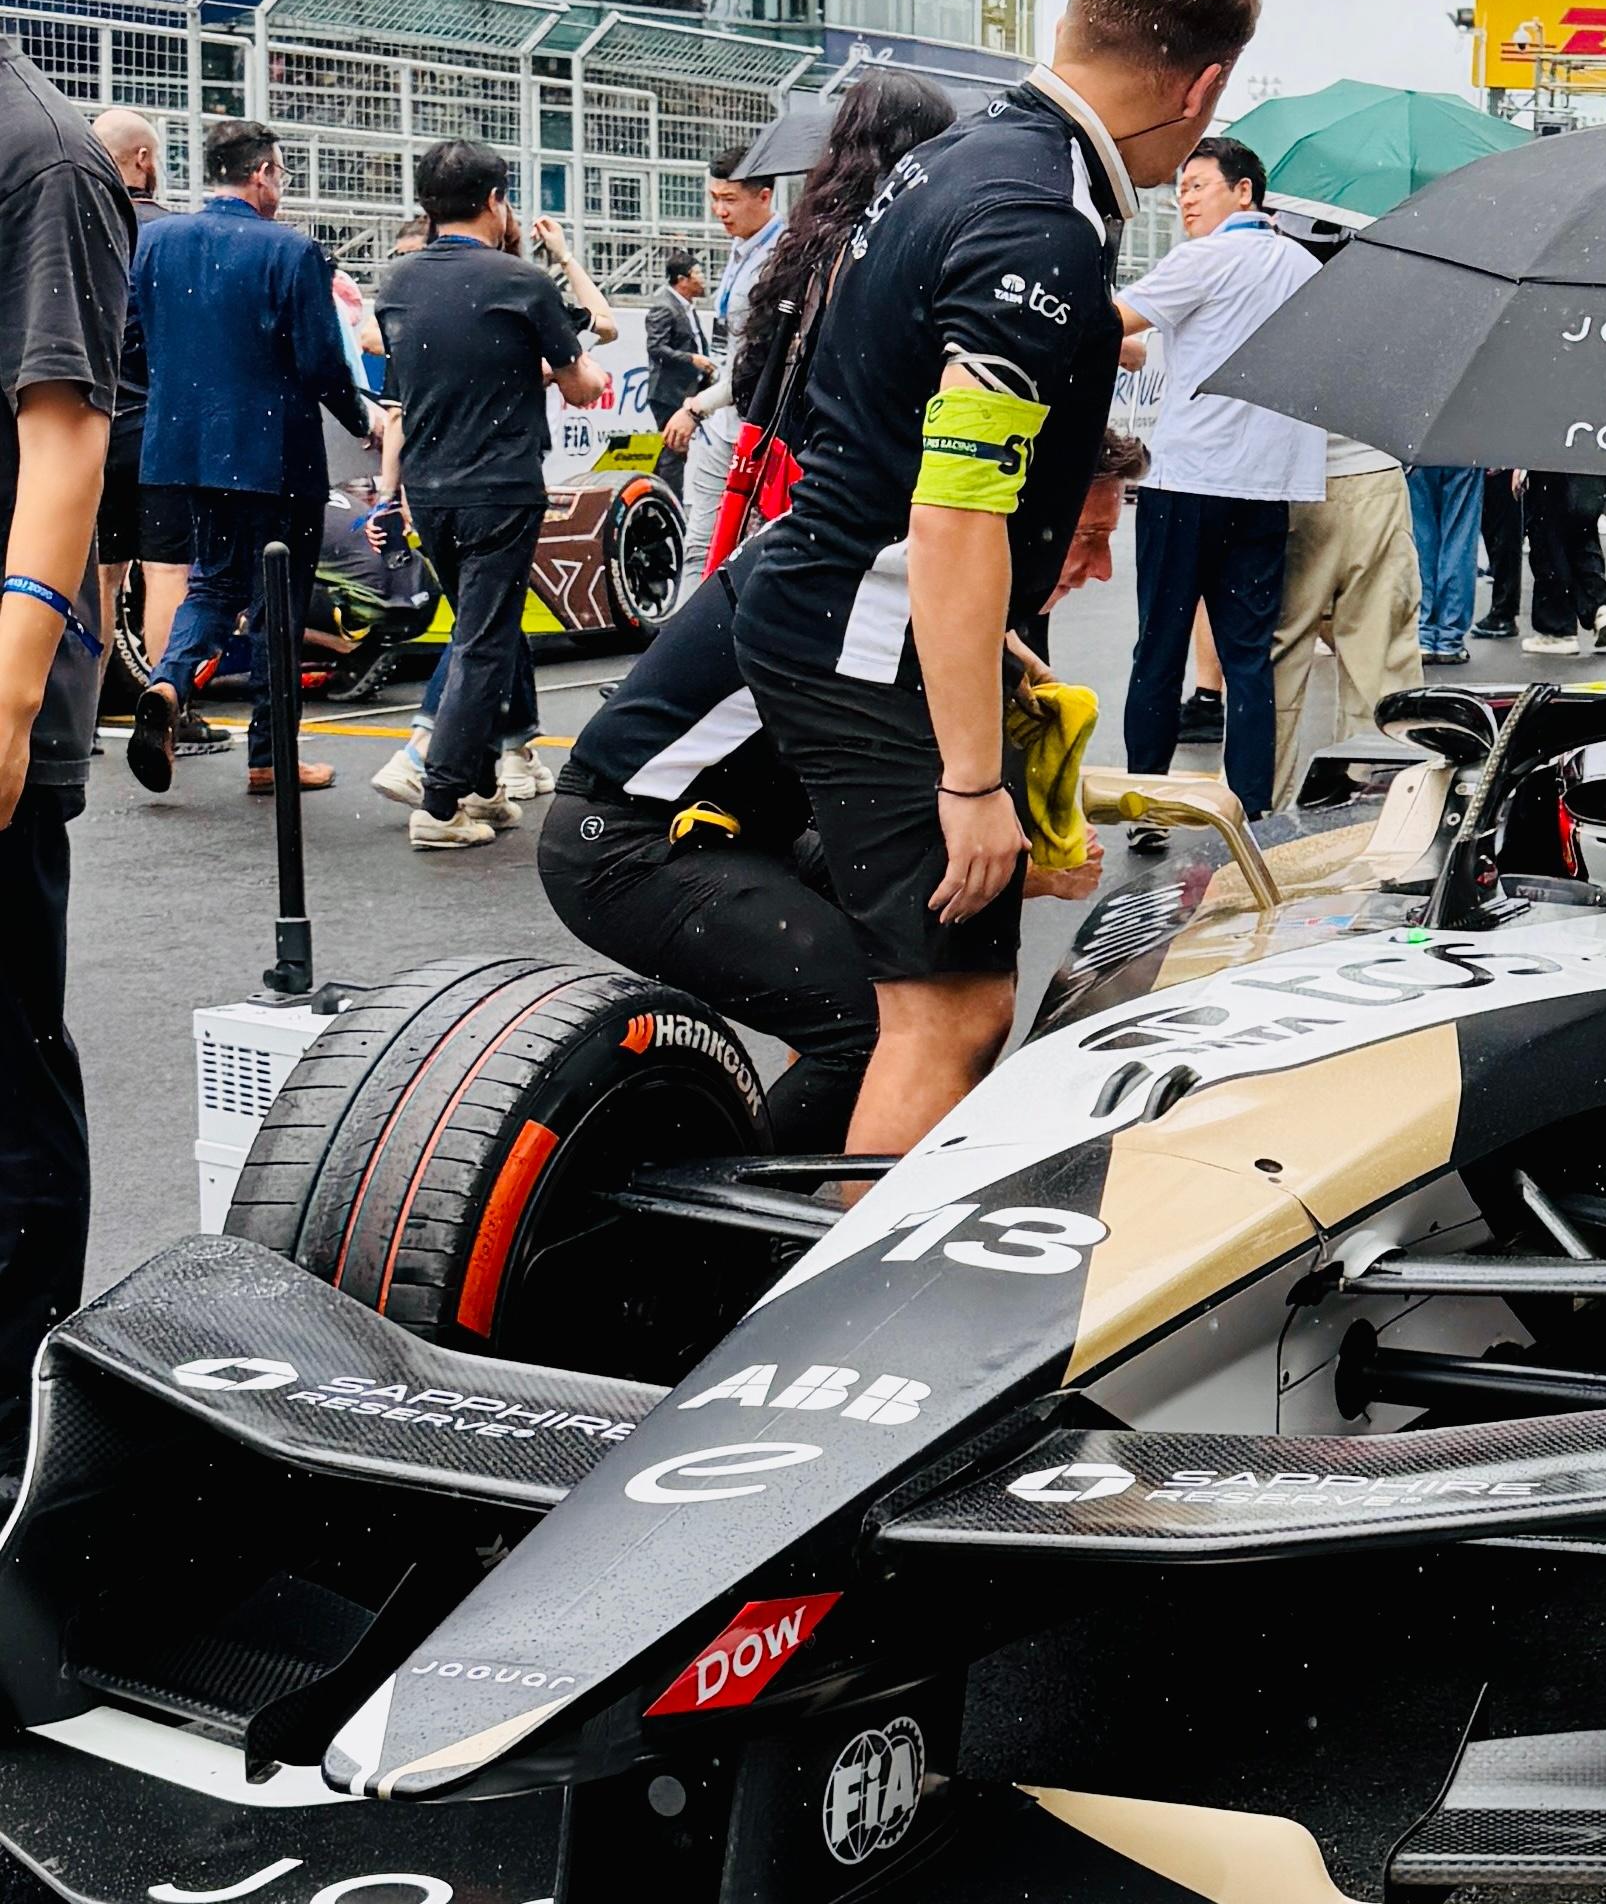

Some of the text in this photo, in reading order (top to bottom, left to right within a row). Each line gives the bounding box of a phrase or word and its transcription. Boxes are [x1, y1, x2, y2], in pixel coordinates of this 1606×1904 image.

[1028, 281, 1072, 325] tcs
[881, 1203, 1110, 1275] 13
[318, 1375, 637, 1442] SAPPHIRE
[678, 1363, 932, 1426] ABB
[1161, 1469, 1542, 1497] SAPPHIRE
[694, 1607, 808, 1706] DOW
[831, 1738, 914, 1842] FIA
